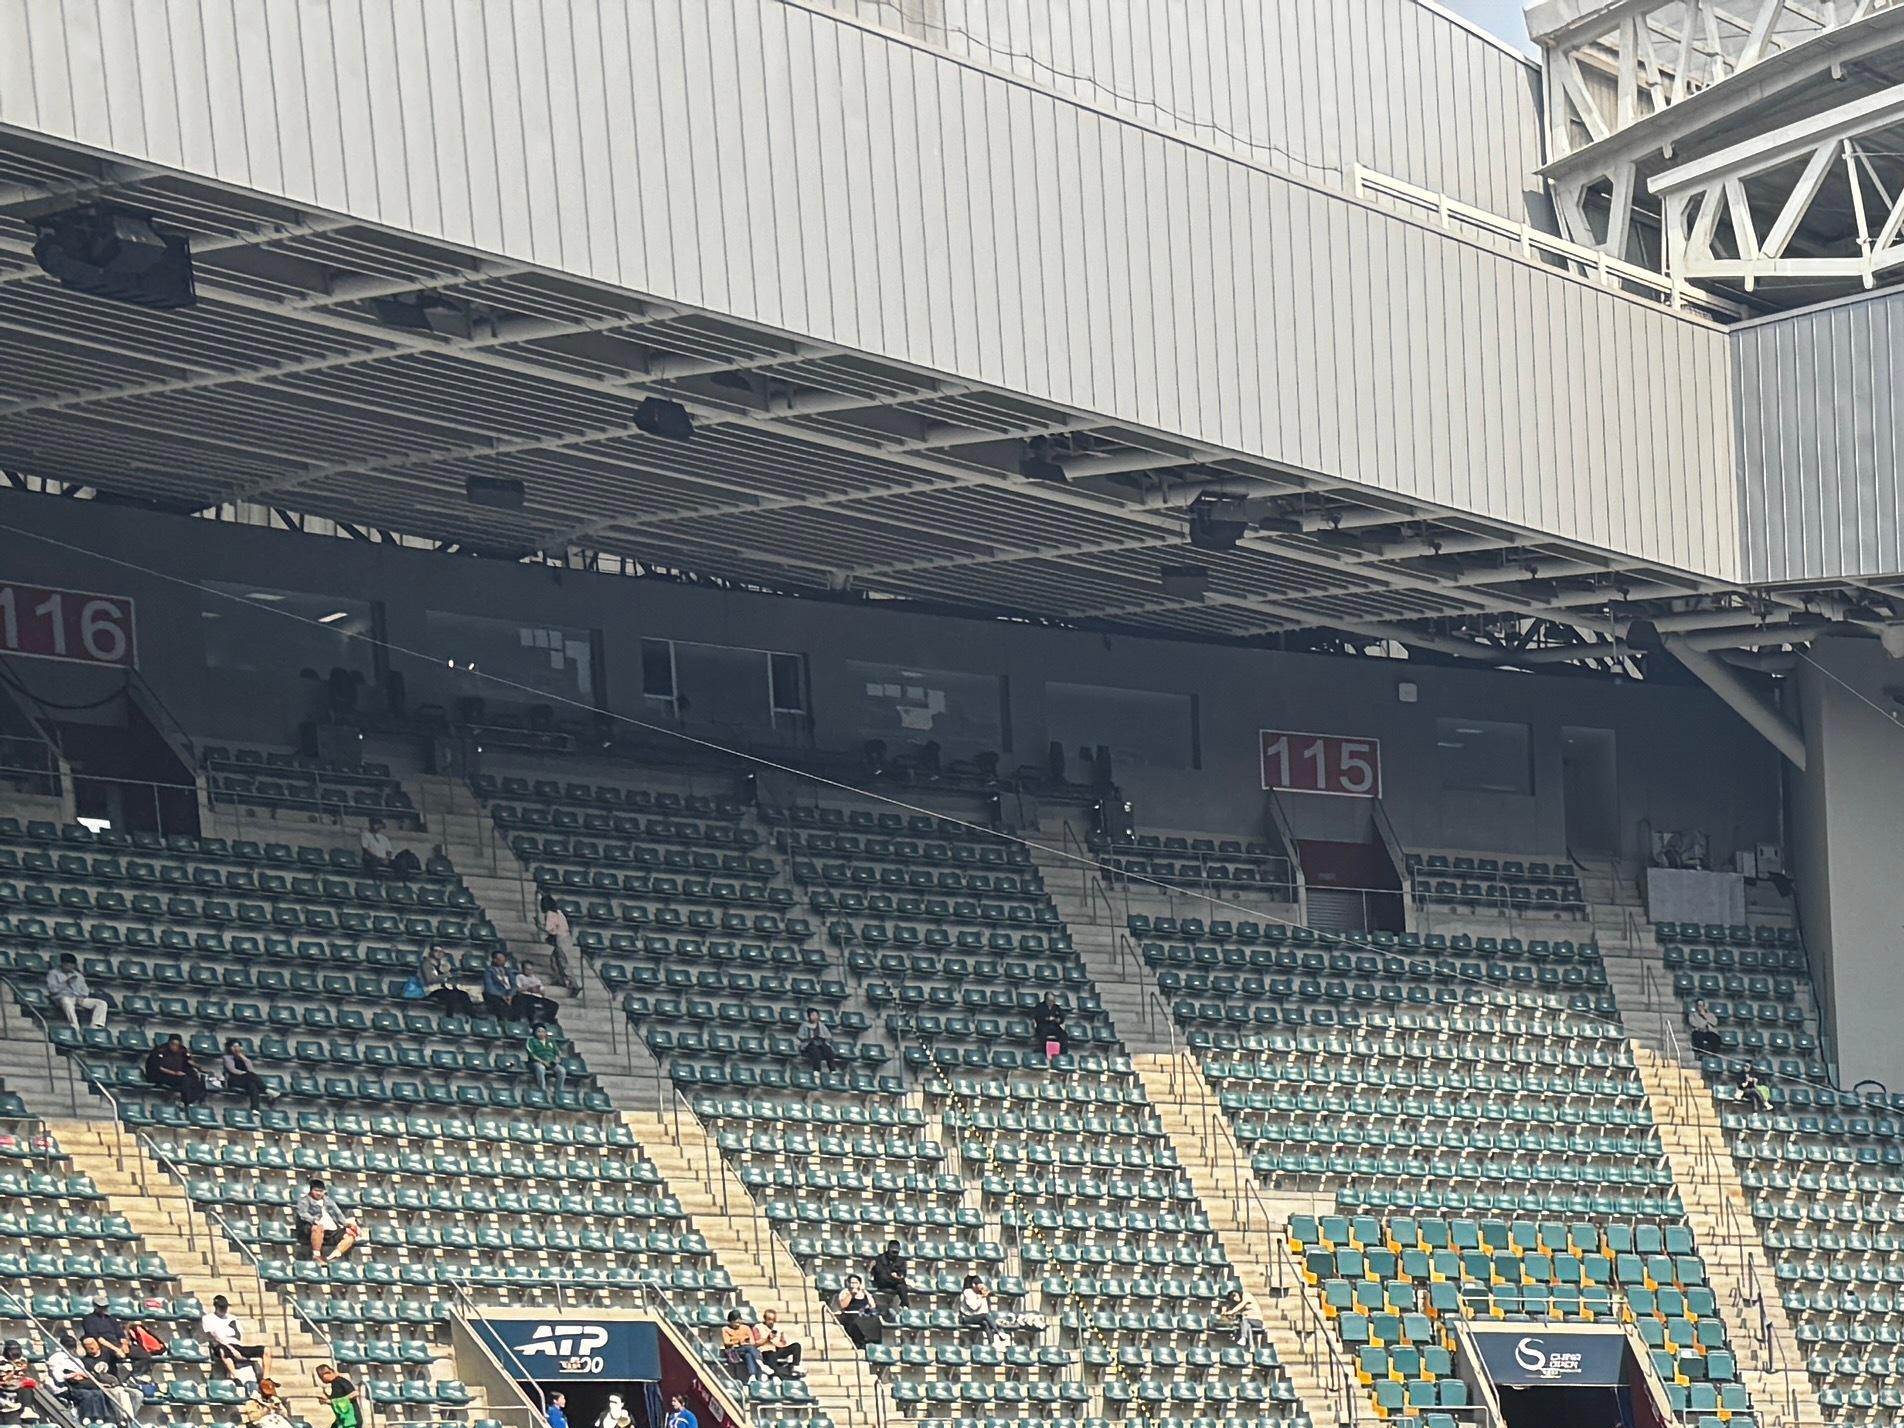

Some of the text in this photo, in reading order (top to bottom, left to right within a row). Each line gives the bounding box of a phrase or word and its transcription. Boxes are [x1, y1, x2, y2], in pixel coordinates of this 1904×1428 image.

[0, 587, 127, 661] 116
[1267, 736, 1373, 792] 115
[513, 1325, 609, 1356] ATP
